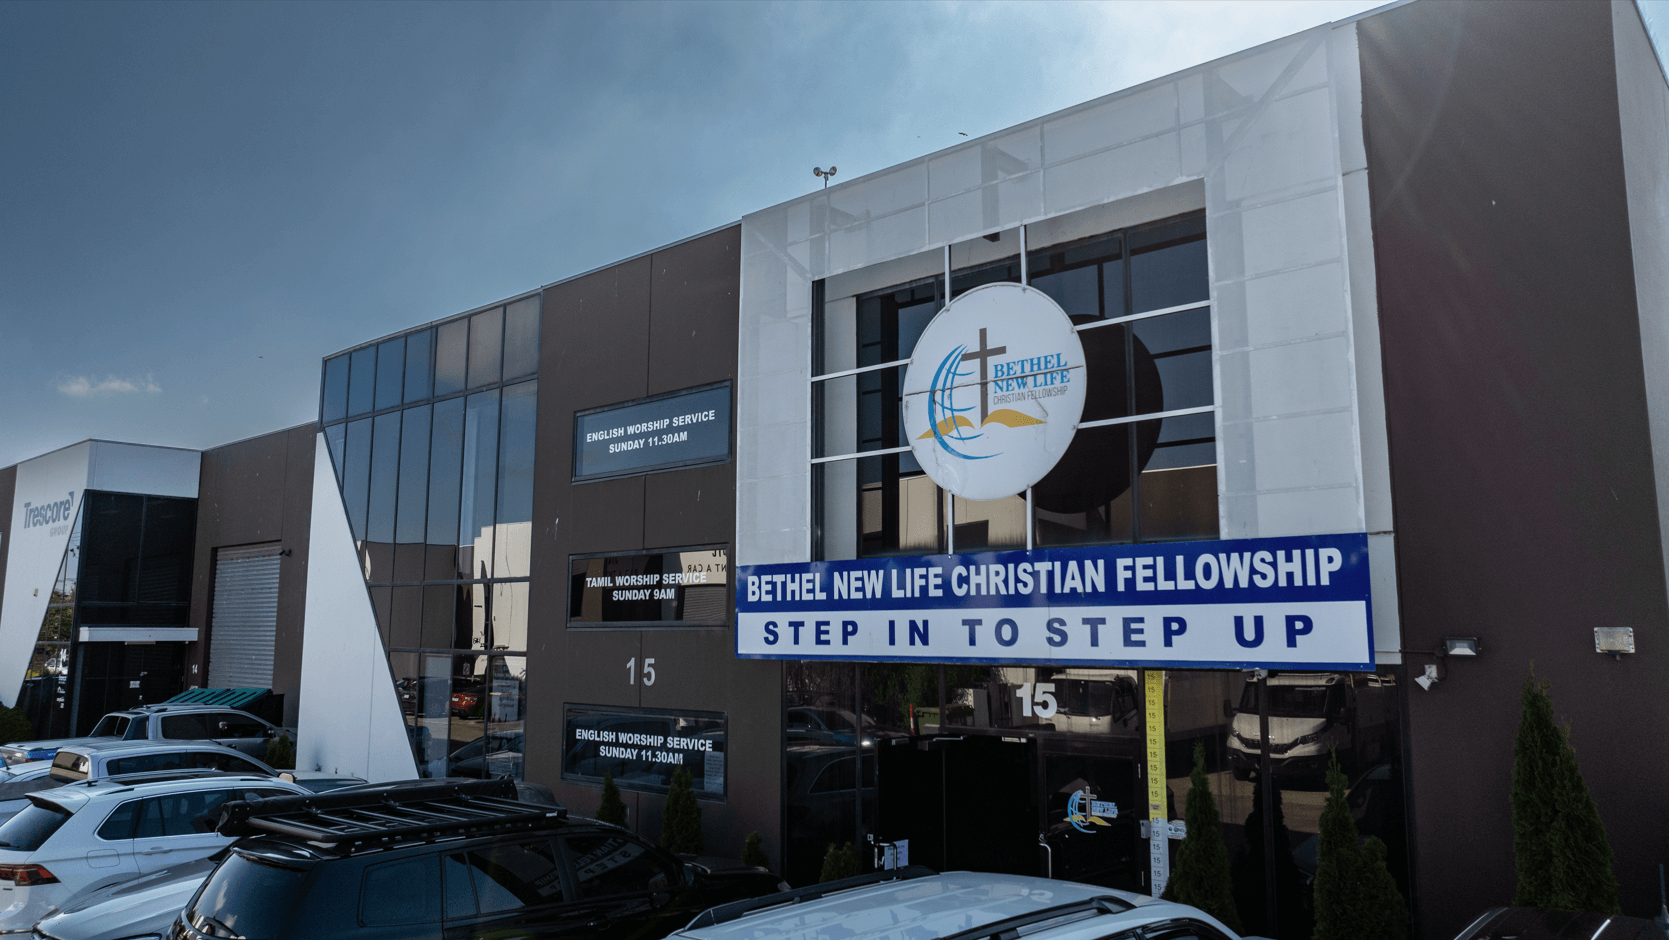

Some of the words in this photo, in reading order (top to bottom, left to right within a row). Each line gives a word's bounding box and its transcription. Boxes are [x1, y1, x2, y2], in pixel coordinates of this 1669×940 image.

[993, 353, 1068, 379] BETHEL
[993, 377, 1028, 394] NEW
[1033, 369, 1071, 388] LIFE
[993, 391, 1026, 406] CHRISTIAN
[1027, 385, 1068, 400] FELLOWSHIP
[586, 427, 624, 443] ENGLISH
[627, 418, 670, 435] WORSHIP
[672, 410, 716, 427] SERVICE
[608, 438, 646, 454] SUNDAY
[647, 431, 688, 447] 11.30AM
[24, 499, 71, 529] Trescore
[586, 577, 613, 588] TAMIL
[615, 574, 660, 586] WORSHIP
[662, 572, 707, 585] SERVICE
[747, 573, 827, 602] BETHEL
[833, 570, 884, 600] NEW
[891, 567, 943, 598] LIFE
[951, 559, 1106, 597] CHRISTIAN
[1116, 547, 1343, 592] FELLOWSHIP
[612, 589, 652, 601] SUNDAY
[653, 588, 675, 600] 9AM
[763, 620, 859, 646] STEP
[888, 619, 930, 646] IN
[961, 618, 1019, 647] TO
[1045, 616, 1188, 648] STEP
[1233, 614, 1314, 649] UP
[626, 657, 656, 686] 15
[1016, 682, 1058, 718] 15
[575, 728, 616, 743] ENGLISH
[618, 732, 664, 747] WORSHIP
[666, 736, 713, 751] SERVICE
[599, 745, 638, 760] SUNDAY
[641, 749, 684, 765] 11.30AM
[1153, 843, 1160, 851] 15
